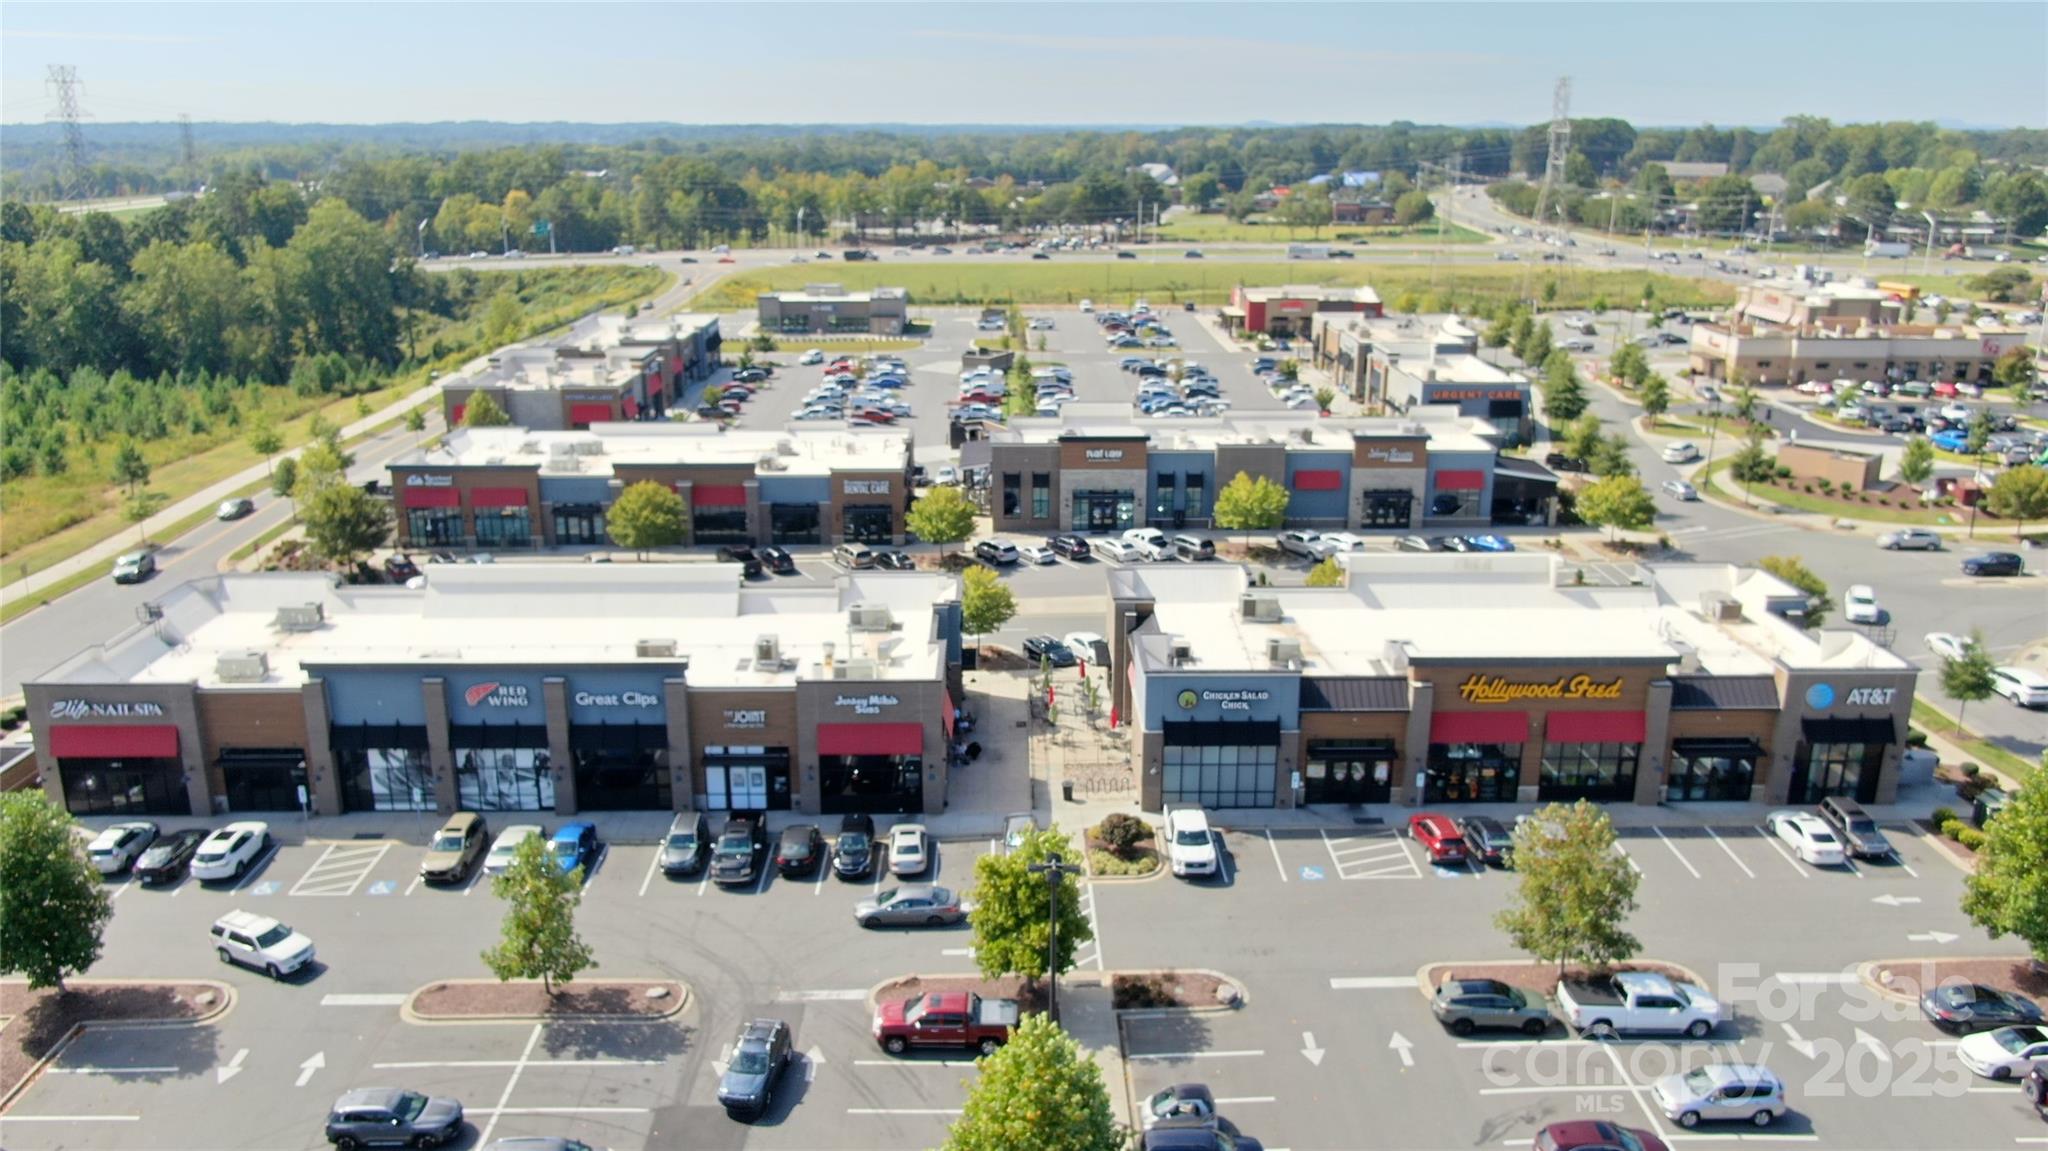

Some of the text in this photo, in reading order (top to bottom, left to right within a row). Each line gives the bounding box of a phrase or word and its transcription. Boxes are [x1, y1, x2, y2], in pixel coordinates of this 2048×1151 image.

[1432, 390, 1521, 400] URGENT CARE
[499, 686, 527, 696] RED
[1460, 674, 1623, 703] Hollywood Feed
[488, 696, 529, 707] WING
[575, 692, 659, 708] Great Clips
[1846, 687, 1896, 705] AT&T
[92, 703, 132, 717] NAIL
[133, 703, 163, 717] SPA
